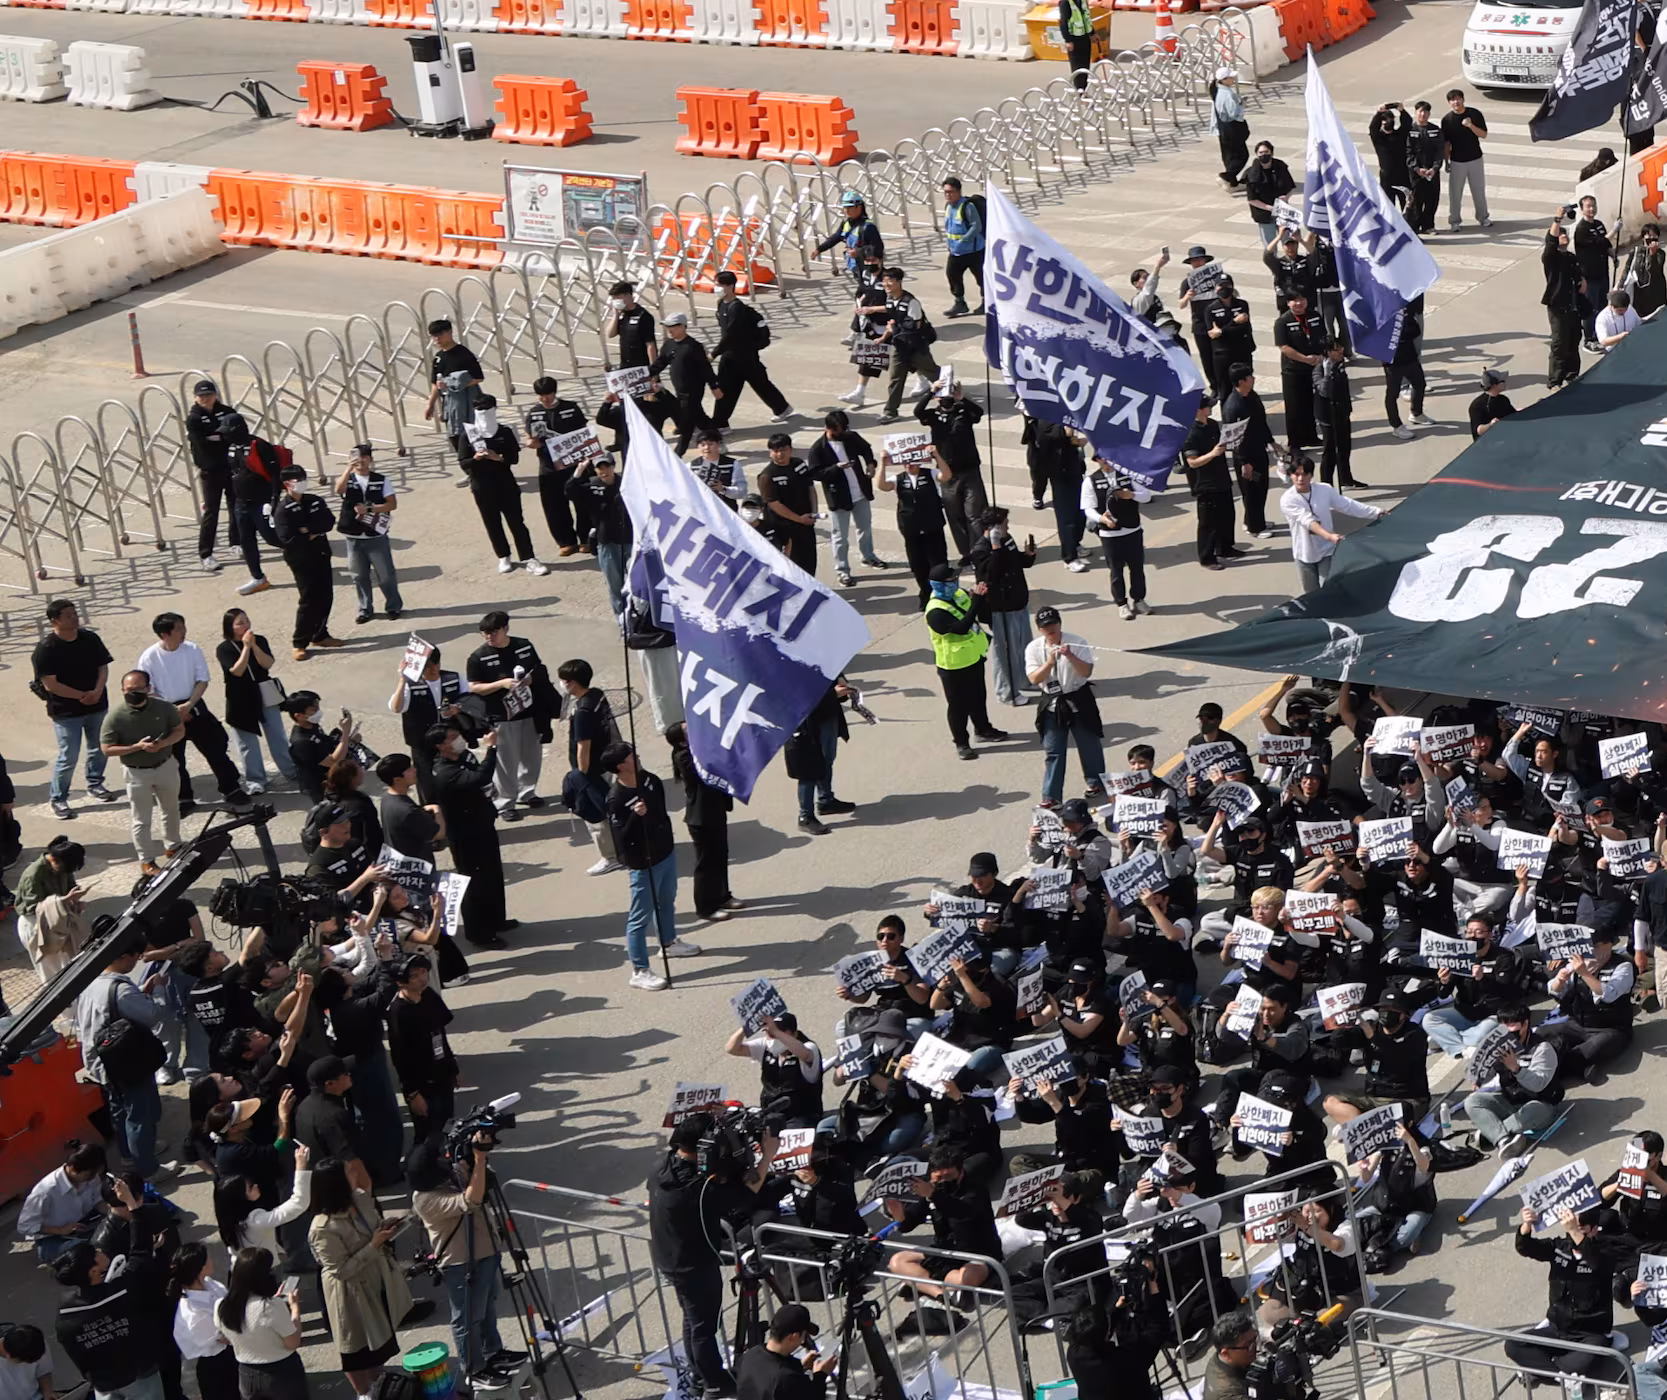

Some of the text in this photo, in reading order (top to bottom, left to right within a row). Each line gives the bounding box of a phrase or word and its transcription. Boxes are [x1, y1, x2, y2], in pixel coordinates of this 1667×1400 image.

[991, 239, 1156, 353] 상한폐
[610, 369, 649, 386] 투명하게
[888, 435, 927, 448] 투명하게
[892, 449, 930, 463] 바꾸고!!!
[1262, 737, 1306, 751] 투명하게
[1424, 729, 1472, 745] 투명하게
[1429, 743, 1472, 761] 바꾸고!!!
[1604, 737, 1646, 758] 상한폐지
[1117, 799, 1164, 817] 상한폐지
[1301, 824, 1347, 842] 투명하게
[1363, 822, 1410, 842] 상한폐지
[1505, 834, 1550, 853] 상한폐지
[1289, 894, 1334, 914] 투명하게
[1292, 915, 1334, 932] 바꾸고!!!
[1541, 927, 1588, 947] 상한폐지
[1425, 938, 1474, 955] 상한폐지
[1426, 955, 1474, 972] 실현하자
[1009, 1044, 1068, 1076] 상한폐지
[1240, 1100, 1287, 1126] 상한폐지
[1346, 1106, 1399, 1145] 상한폐지
[1239, 1122, 1288, 1152] 실현하자
[1528, 1165, 1585, 1210] 상한폐지
